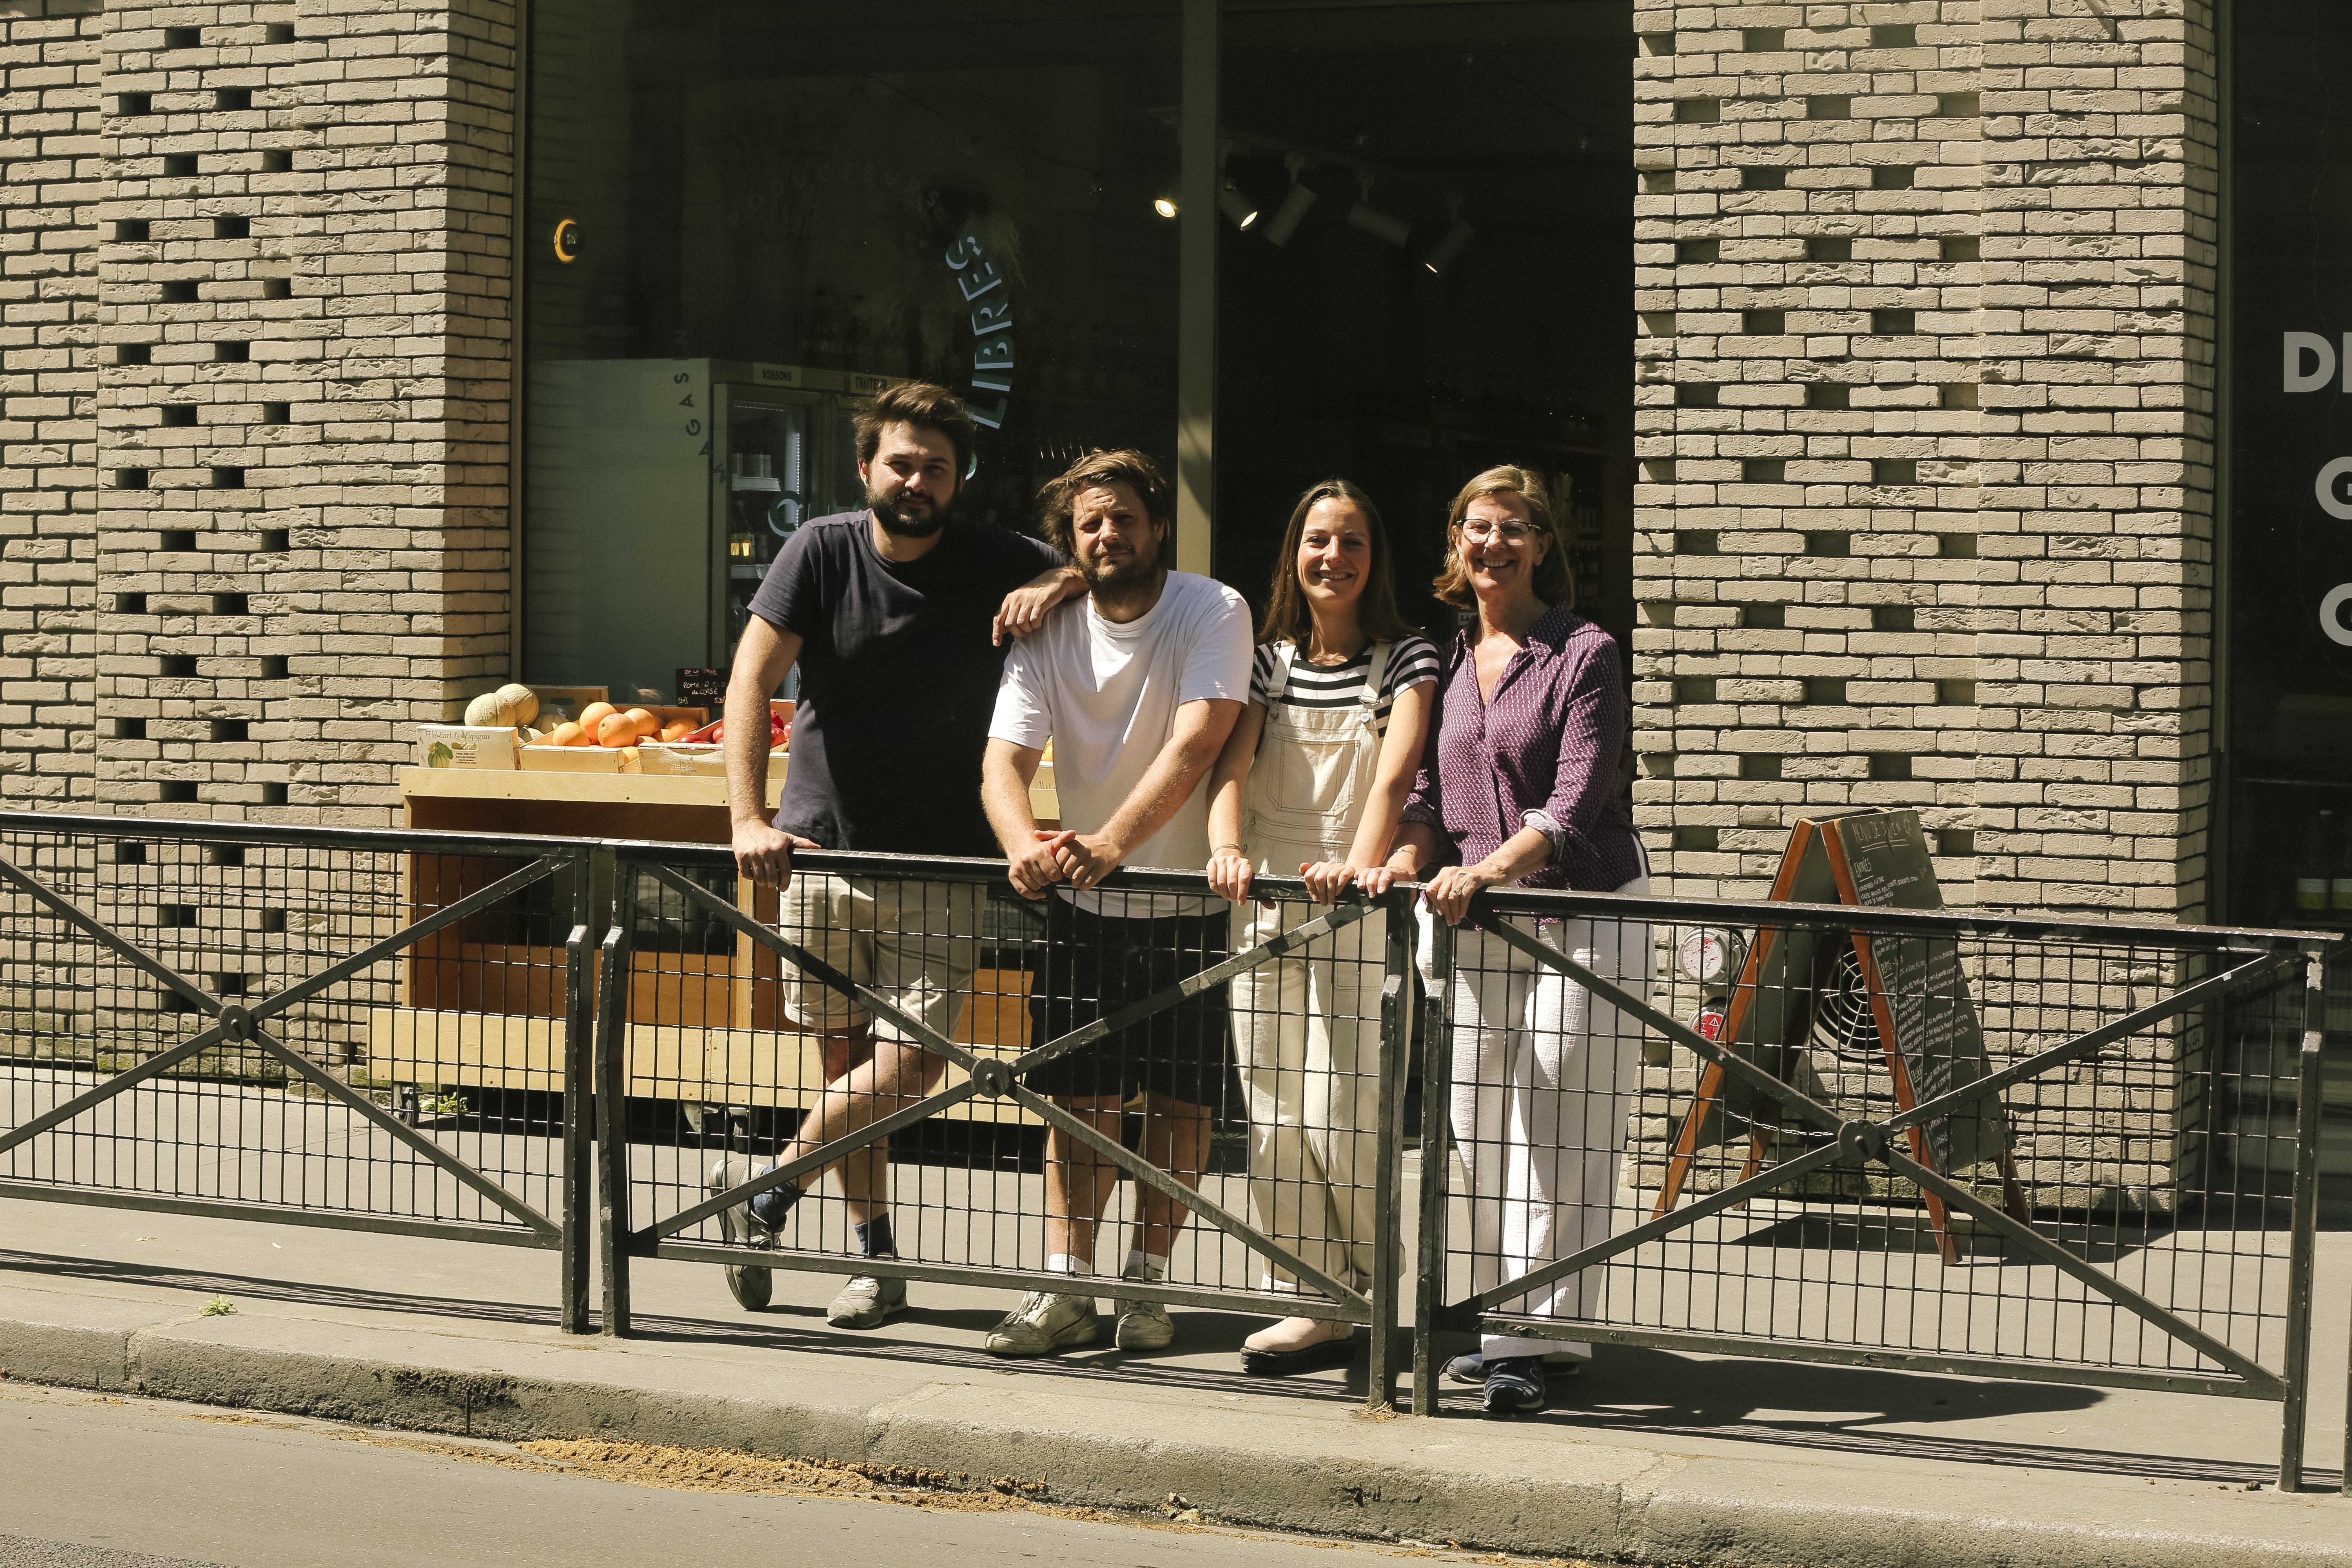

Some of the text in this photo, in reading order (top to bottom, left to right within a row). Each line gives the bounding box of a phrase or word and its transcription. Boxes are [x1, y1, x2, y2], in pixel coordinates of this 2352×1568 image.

[946, 229, 1015, 430] LIBRES
[762, 369, 792, 381] BOISSONS
[2284, 332, 2352, 393] D
